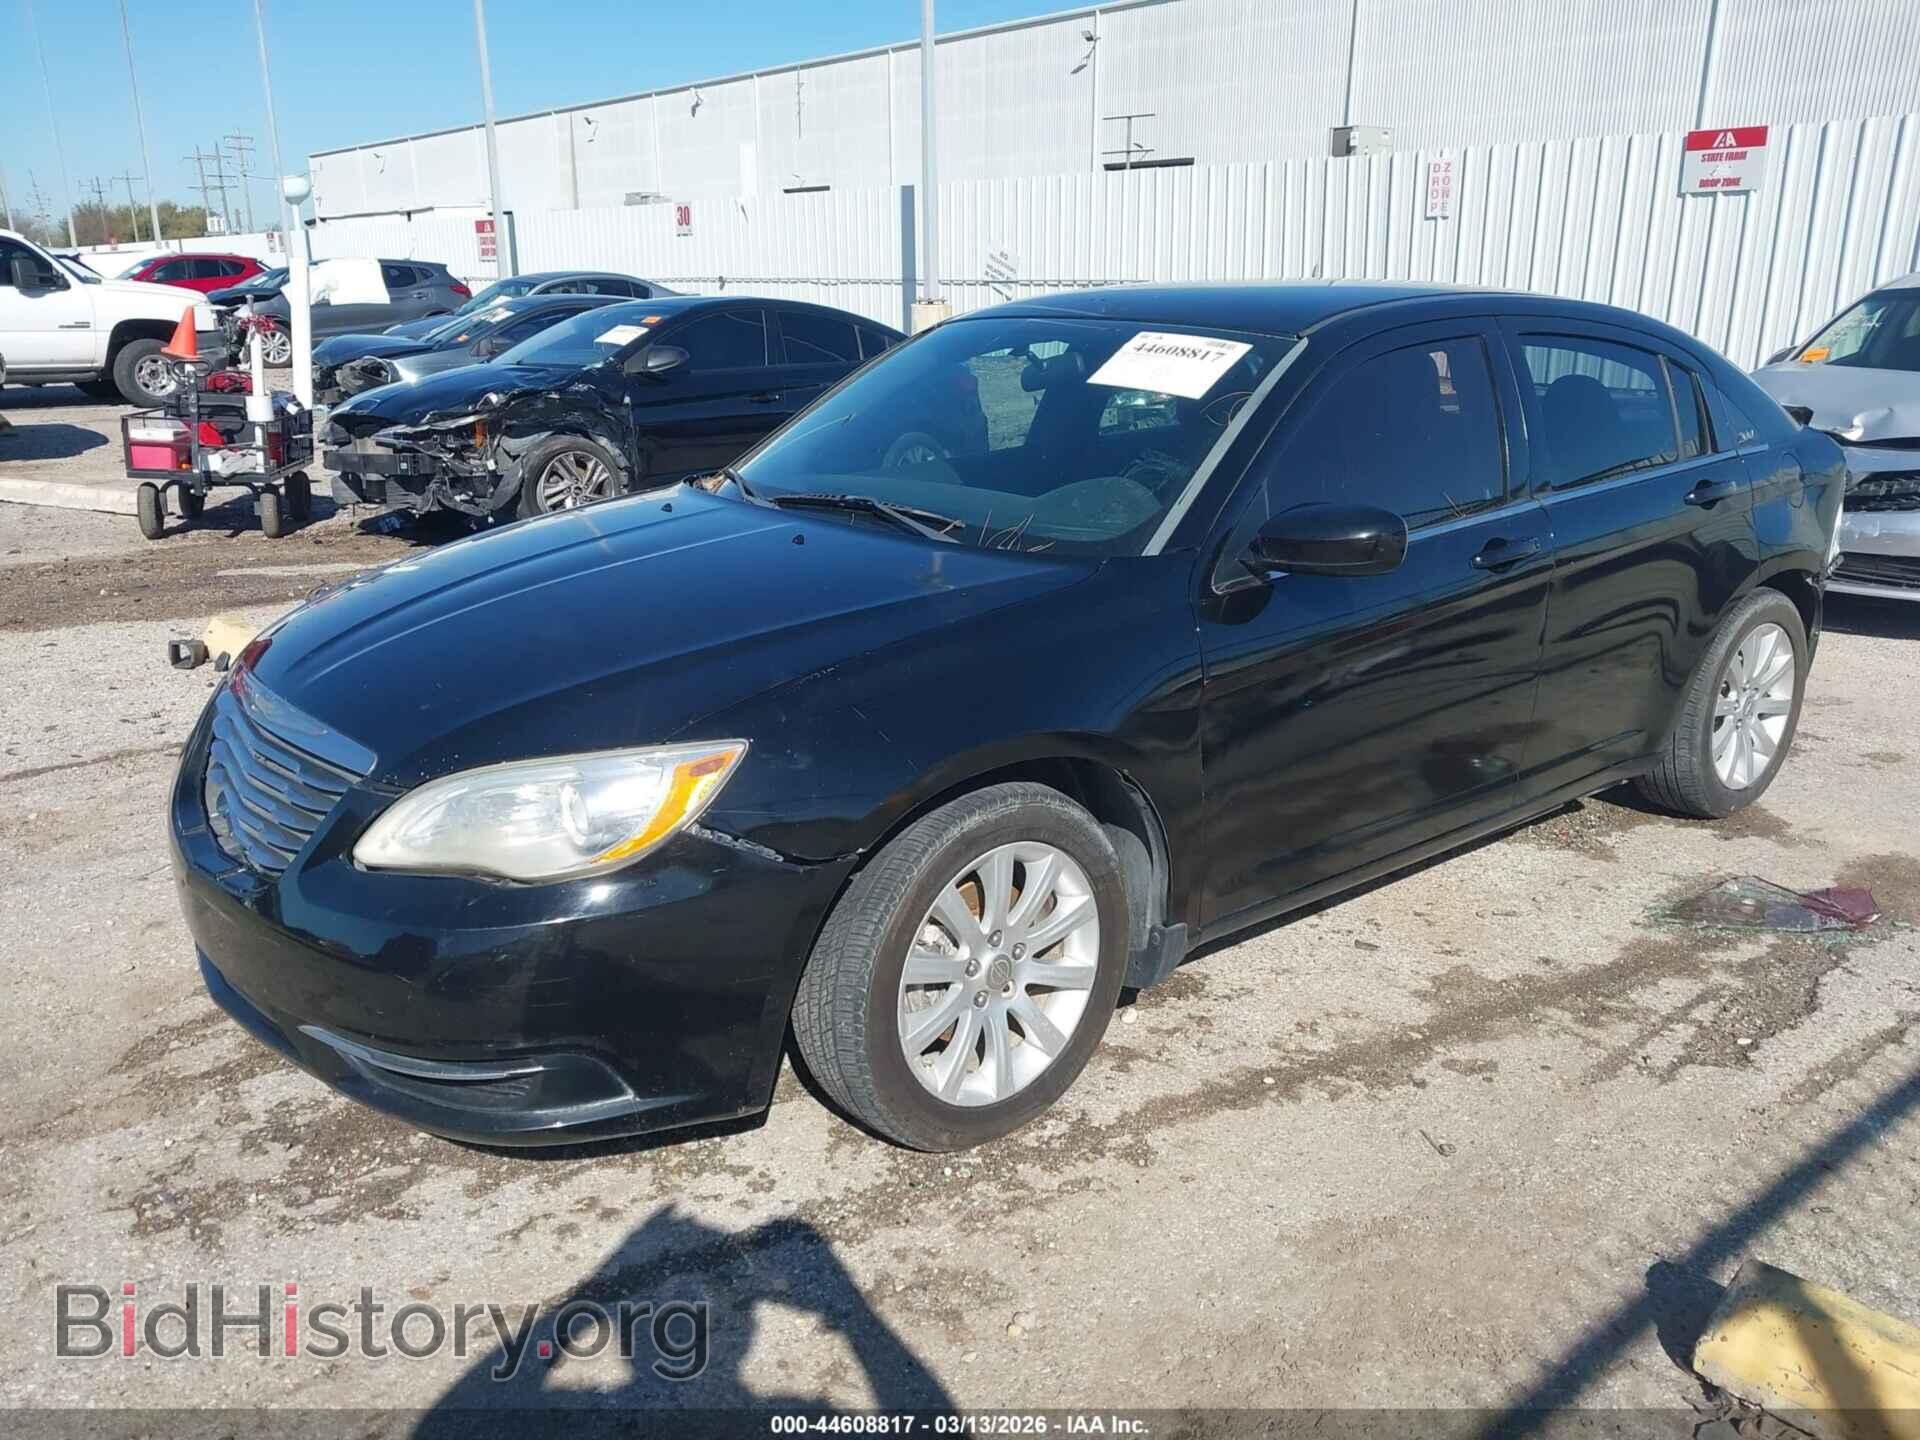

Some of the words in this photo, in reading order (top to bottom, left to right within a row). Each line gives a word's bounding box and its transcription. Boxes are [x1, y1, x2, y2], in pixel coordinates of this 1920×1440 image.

[1700, 153, 1725, 163] STATE
[1698, 178, 1721, 188] DROP
[1721, 177, 1742, 187] ZONE
[676, 205, 690, 226] 30
[1133, 342, 1226, 361] 44608817
